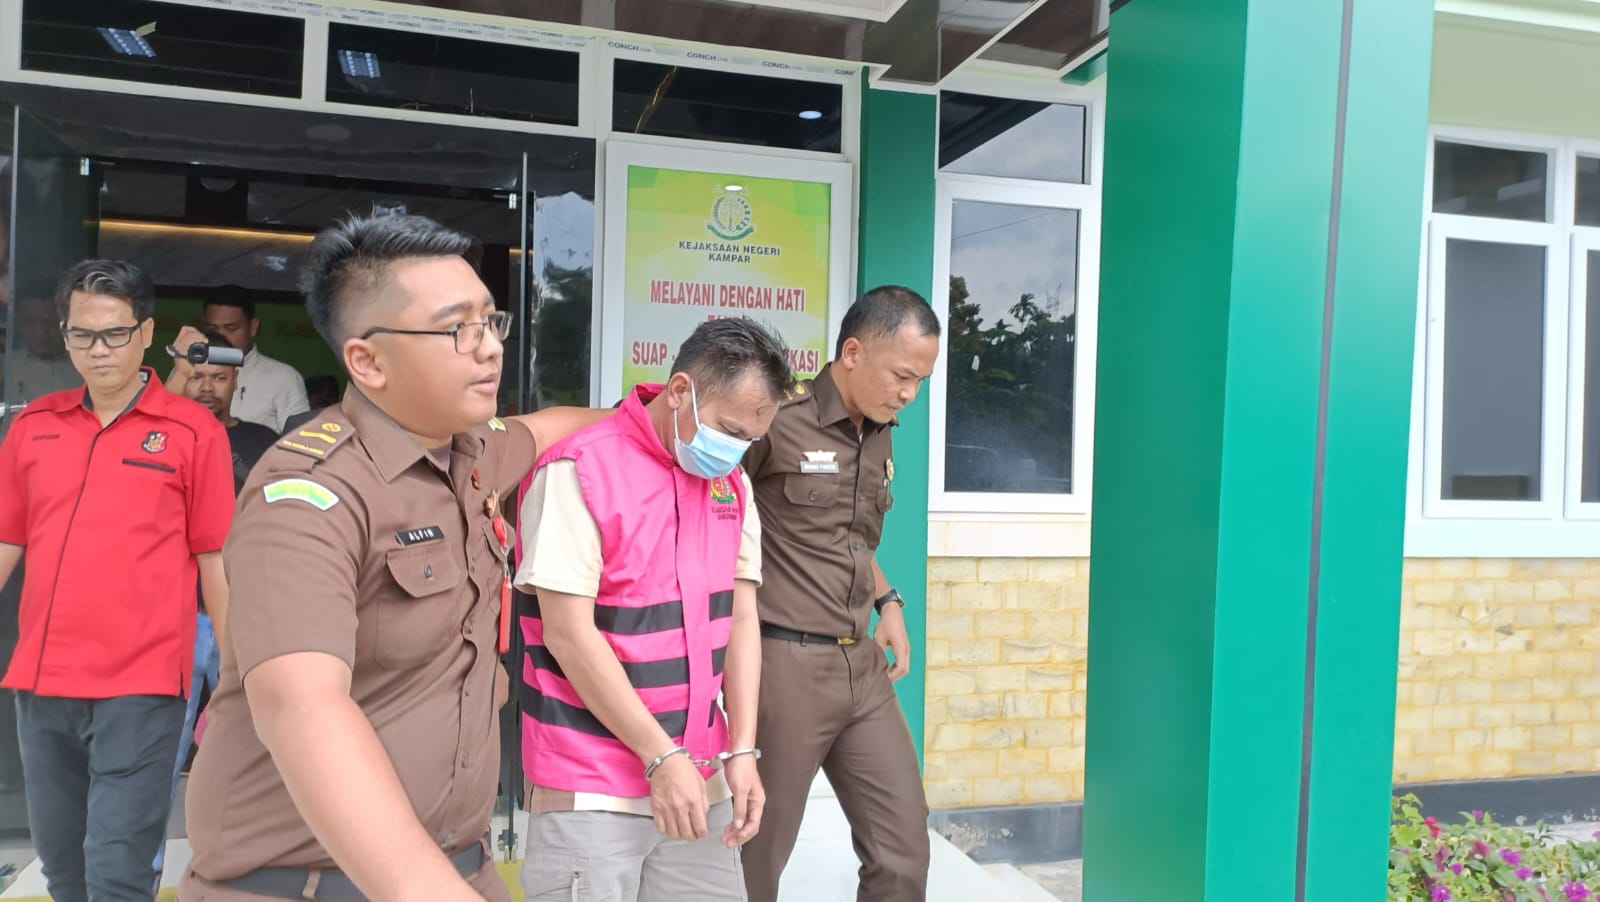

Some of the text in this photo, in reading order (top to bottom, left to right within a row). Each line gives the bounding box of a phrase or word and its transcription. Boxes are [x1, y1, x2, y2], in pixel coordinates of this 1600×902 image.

[608, 41, 639, 52] CONCH
[687, 51, 717, 61] CONCH
[678, 240, 780, 257] KEJAKSAAN NEGERI
[708, 253, 751, 264] KAMPAR
[650, 280, 805, 312] MELAYANI DENGAN HATI
[632, 341, 668, 365] SUAP
[408, 528, 434, 542] ALFIN
